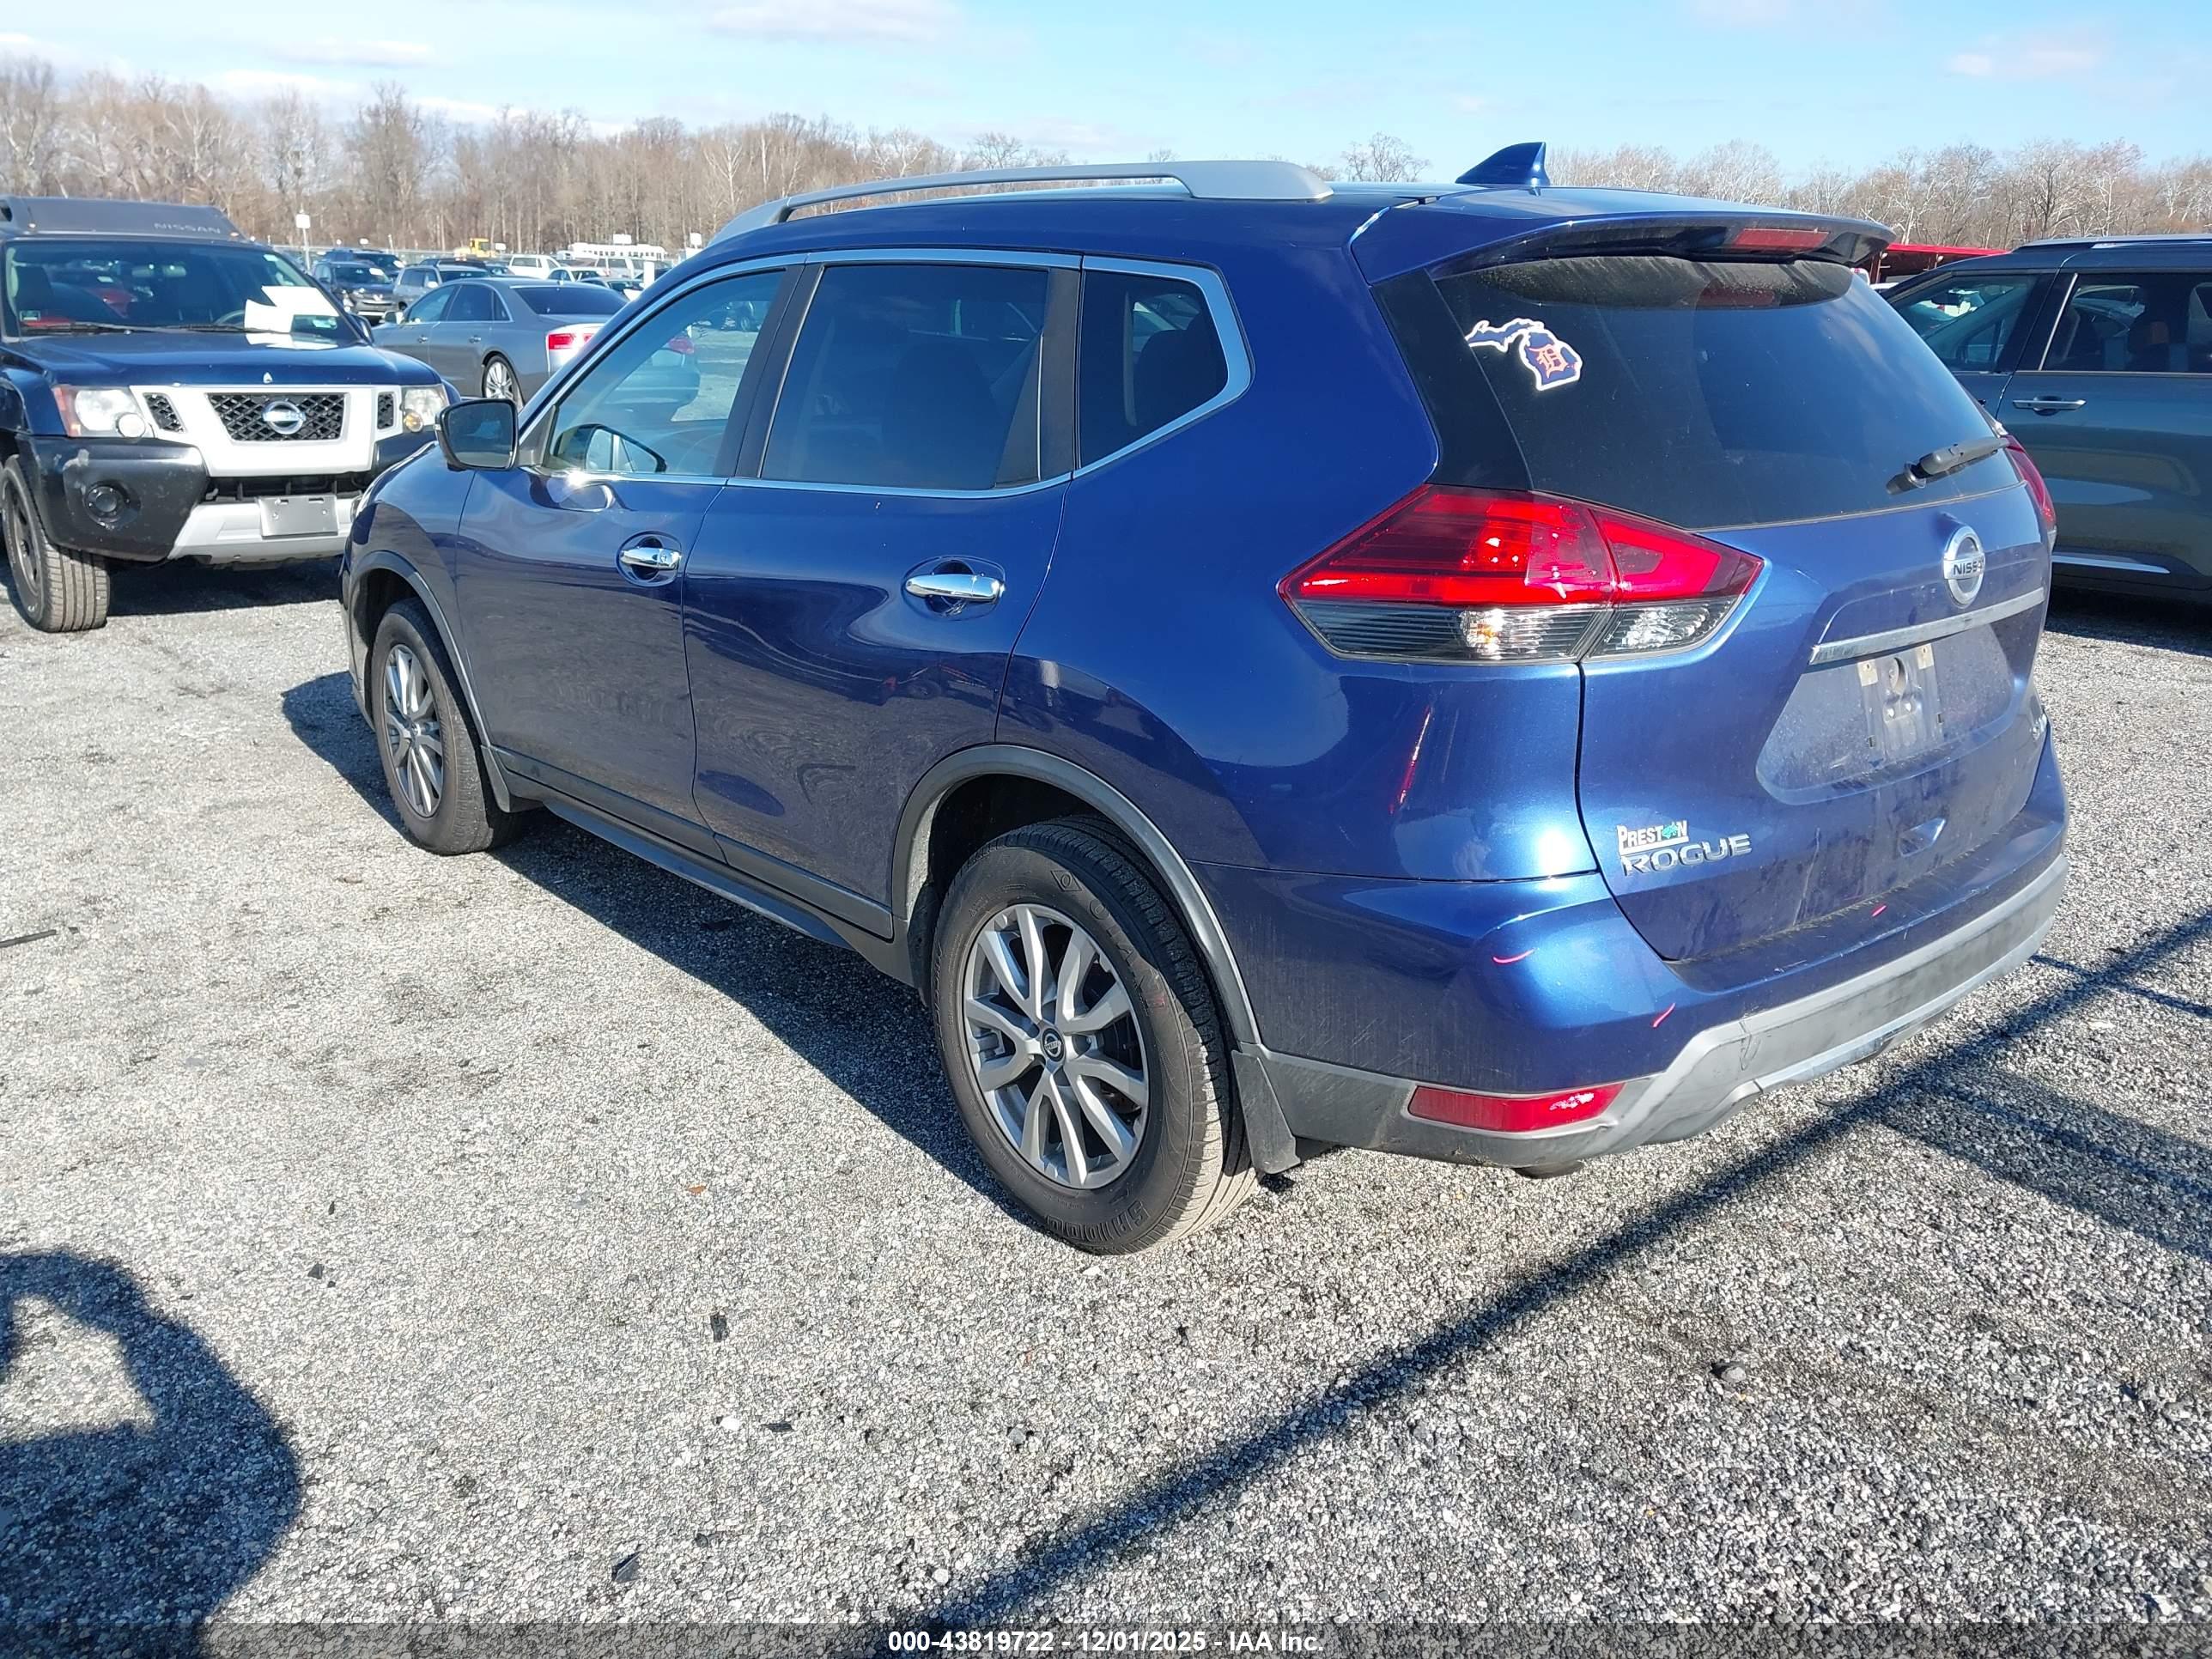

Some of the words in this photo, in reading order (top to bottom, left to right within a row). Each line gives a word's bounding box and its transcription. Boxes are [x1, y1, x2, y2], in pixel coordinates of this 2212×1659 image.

[1953, 554, 1983, 575] NISS
[1616, 819, 1688, 849] PRESTN
[1620, 834, 1753, 877] ROGUE
